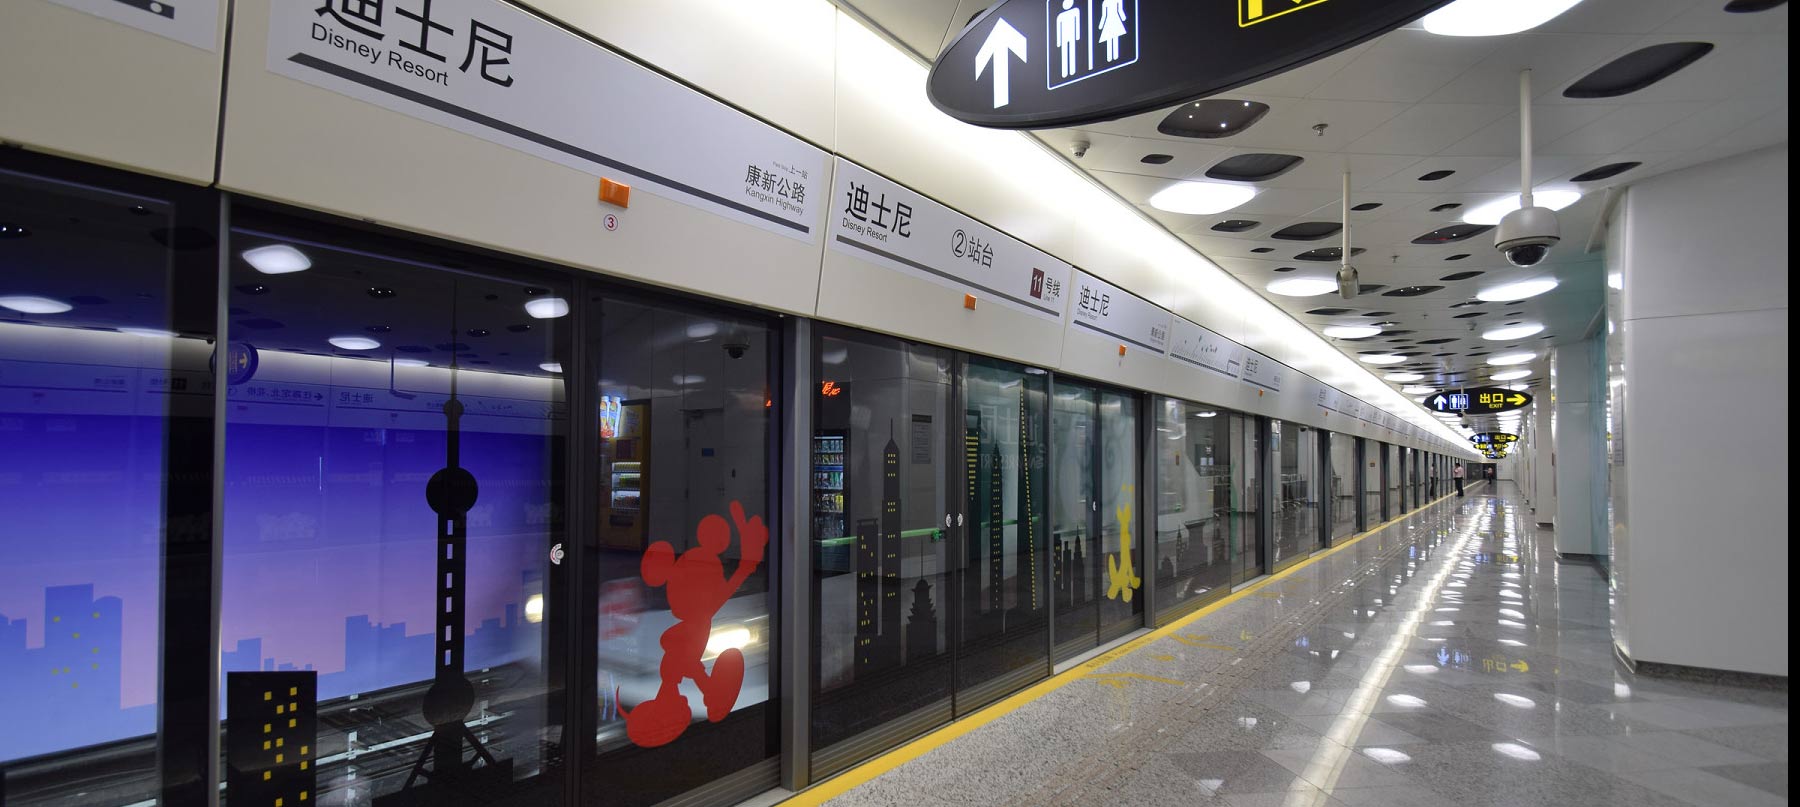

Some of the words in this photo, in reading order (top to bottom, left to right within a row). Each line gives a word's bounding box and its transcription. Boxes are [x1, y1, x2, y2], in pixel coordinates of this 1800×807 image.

[311, 22, 382, 64] Disney
[388, 50, 449, 87] Resort
[314, 0, 514, 88] 迪士尼
[745, 164, 806, 205] 康新公路
[745, 186, 774, 204] Kangxin
[775, 198, 804, 216] Highway
[845, 181, 912, 238] 迪士尼
[842, 217, 866, 236] Disney
[866, 227, 888, 243] Resort
[1078, 285, 1110, 317] 迪士尼
[1479, 393, 1504, 404] 出口
